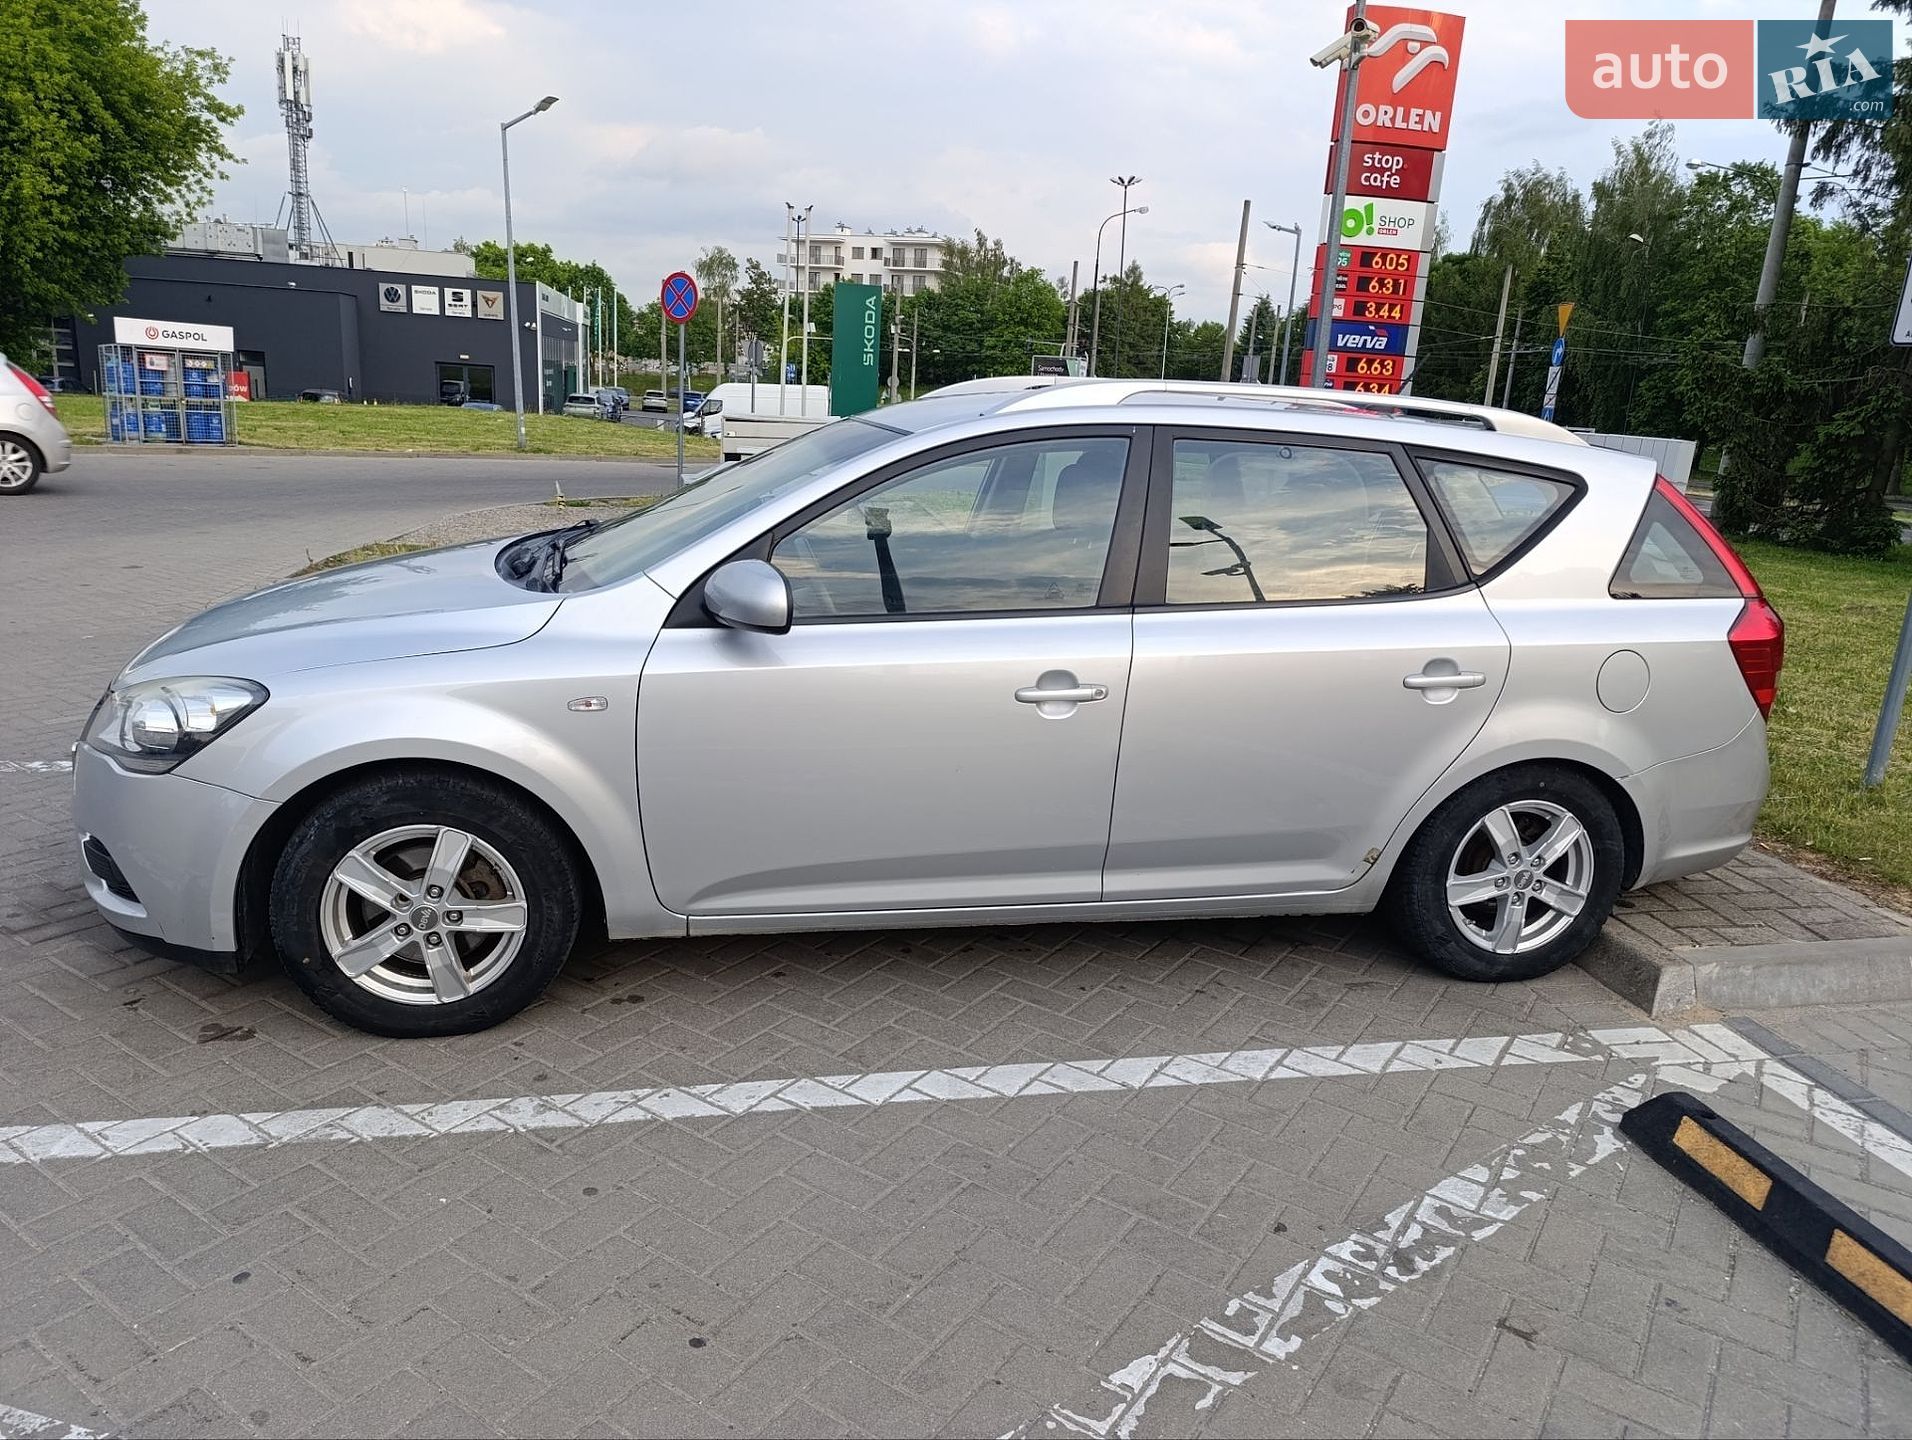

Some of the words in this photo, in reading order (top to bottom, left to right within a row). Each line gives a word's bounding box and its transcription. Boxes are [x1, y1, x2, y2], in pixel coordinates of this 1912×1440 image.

[1355, 103, 1442, 133] ORLEN
[1363, 152, 1403, 171] stop
[1360, 171, 1401, 190] cafe
[1378, 215, 1415, 229] SHOP
[1372, 252, 1409, 271] 6.05
[1369, 277, 1404, 296] 6.31
[1365, 302, 1401, 320] 3.44
[161, 329, 208, 342] GASPOL
[1337, 333, 1388, 349] verva
[1357, 358, 1393, 376] 6.63
[1354, 381, 1390, 395] 634
